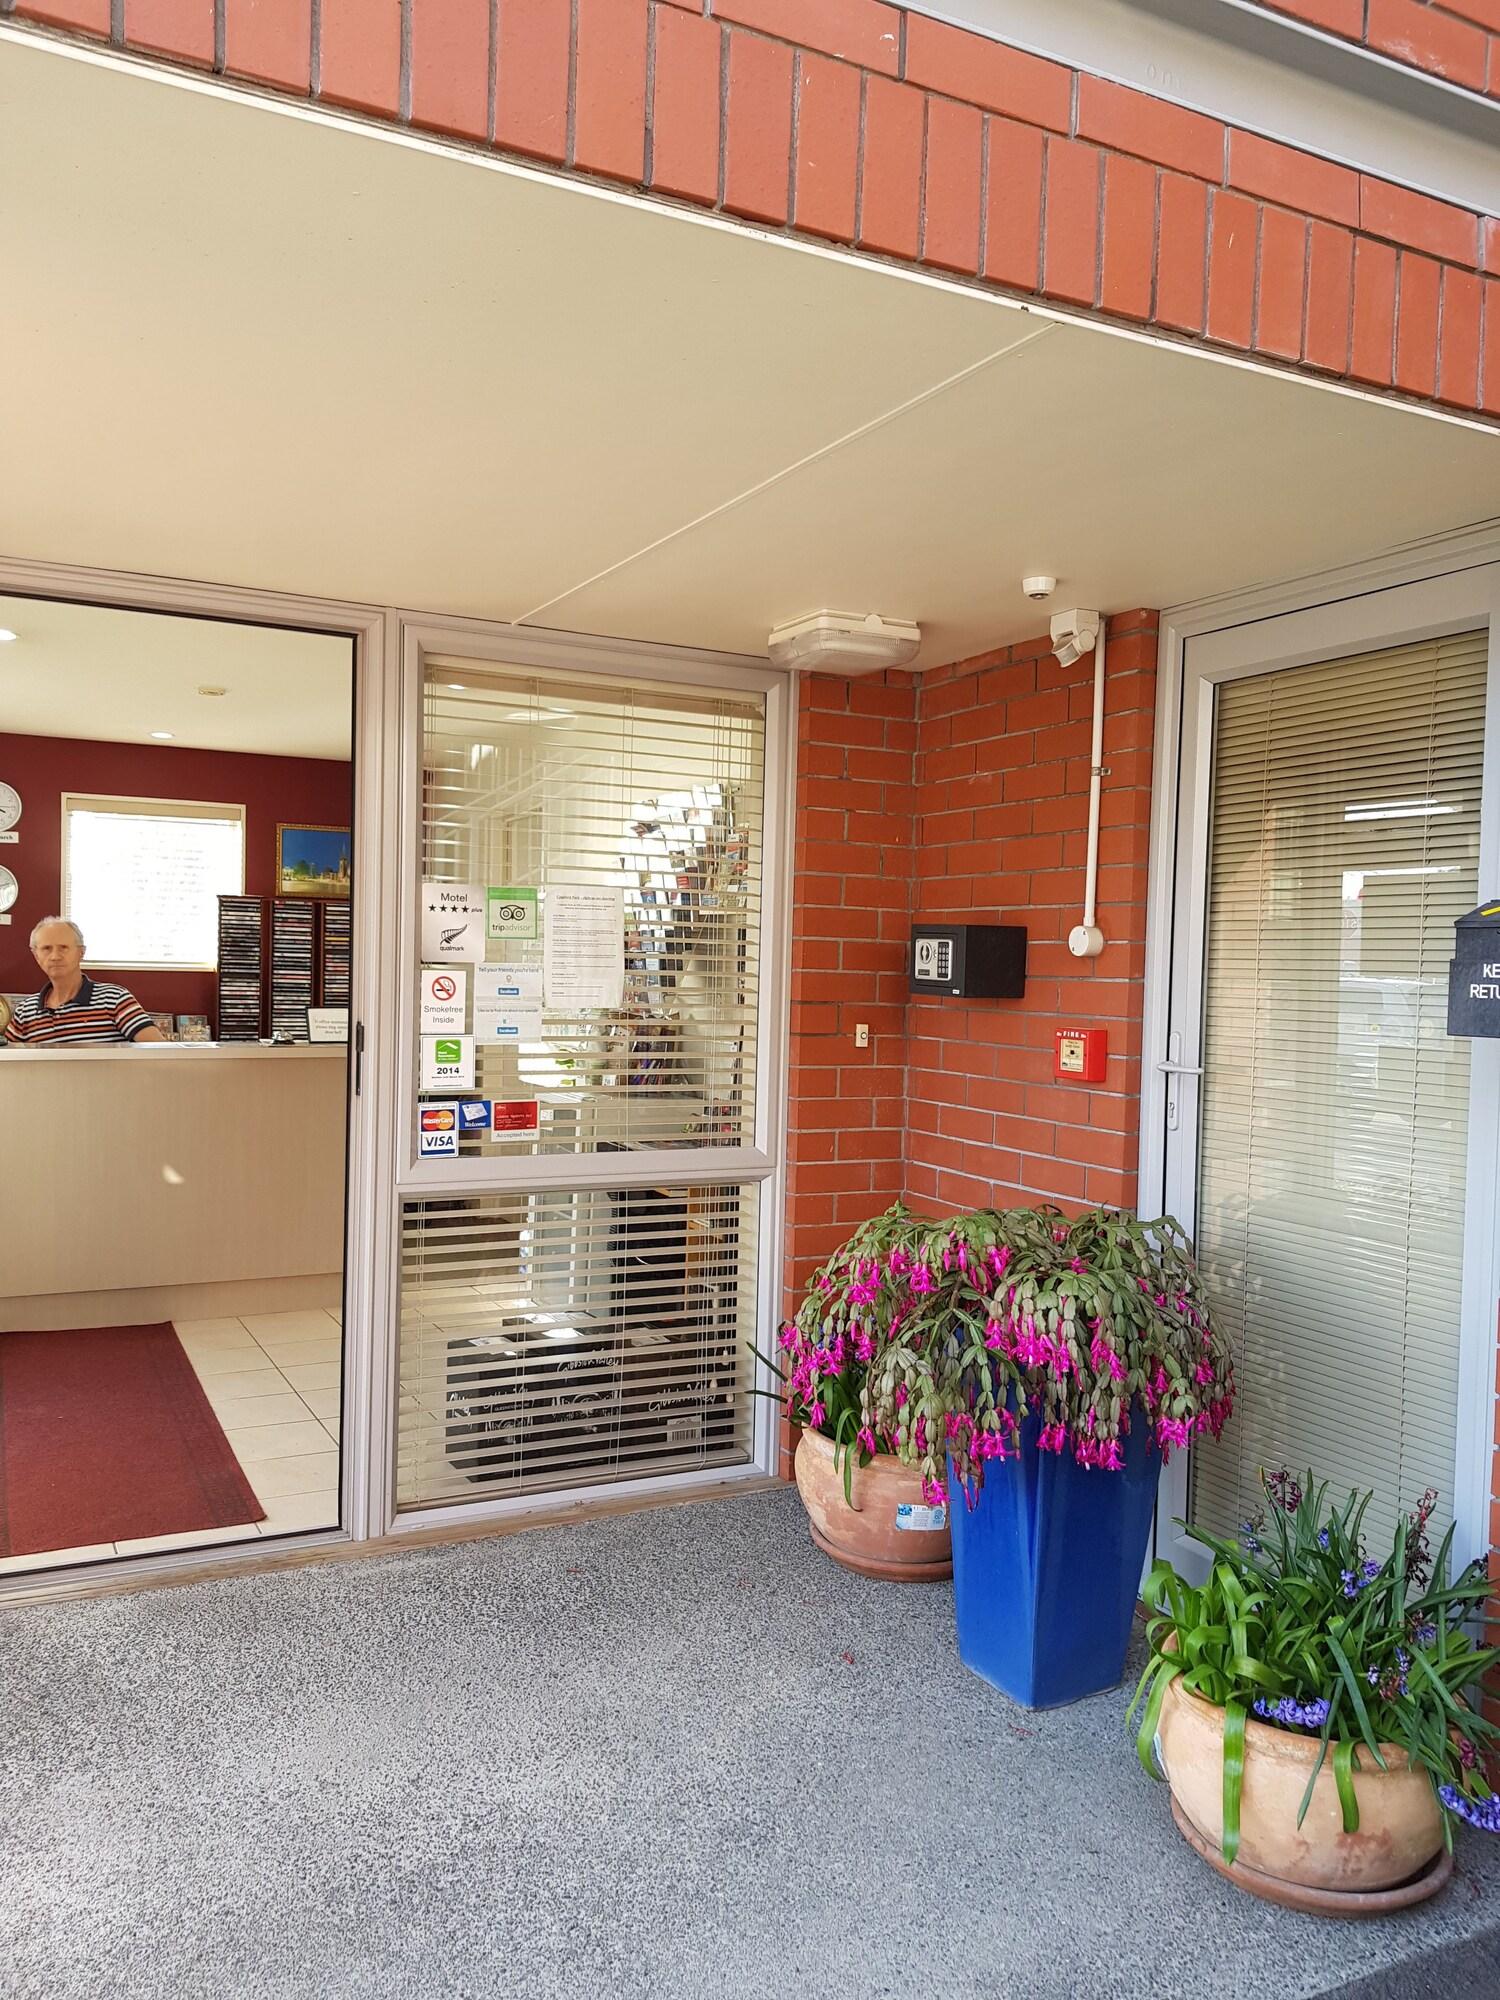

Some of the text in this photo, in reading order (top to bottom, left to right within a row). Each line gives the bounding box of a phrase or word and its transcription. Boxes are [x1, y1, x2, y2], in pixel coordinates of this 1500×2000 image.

[440, 893, 468, 903] Motel
[492, 924, 530, 933] tripadvisor
[423, 1005, 464, 1014] Smokefree
[432, 1016, 455, 1024] Inside
[436, 1067, 460, 1075] 2014
[425, 1136, 454, 1147] VISA
